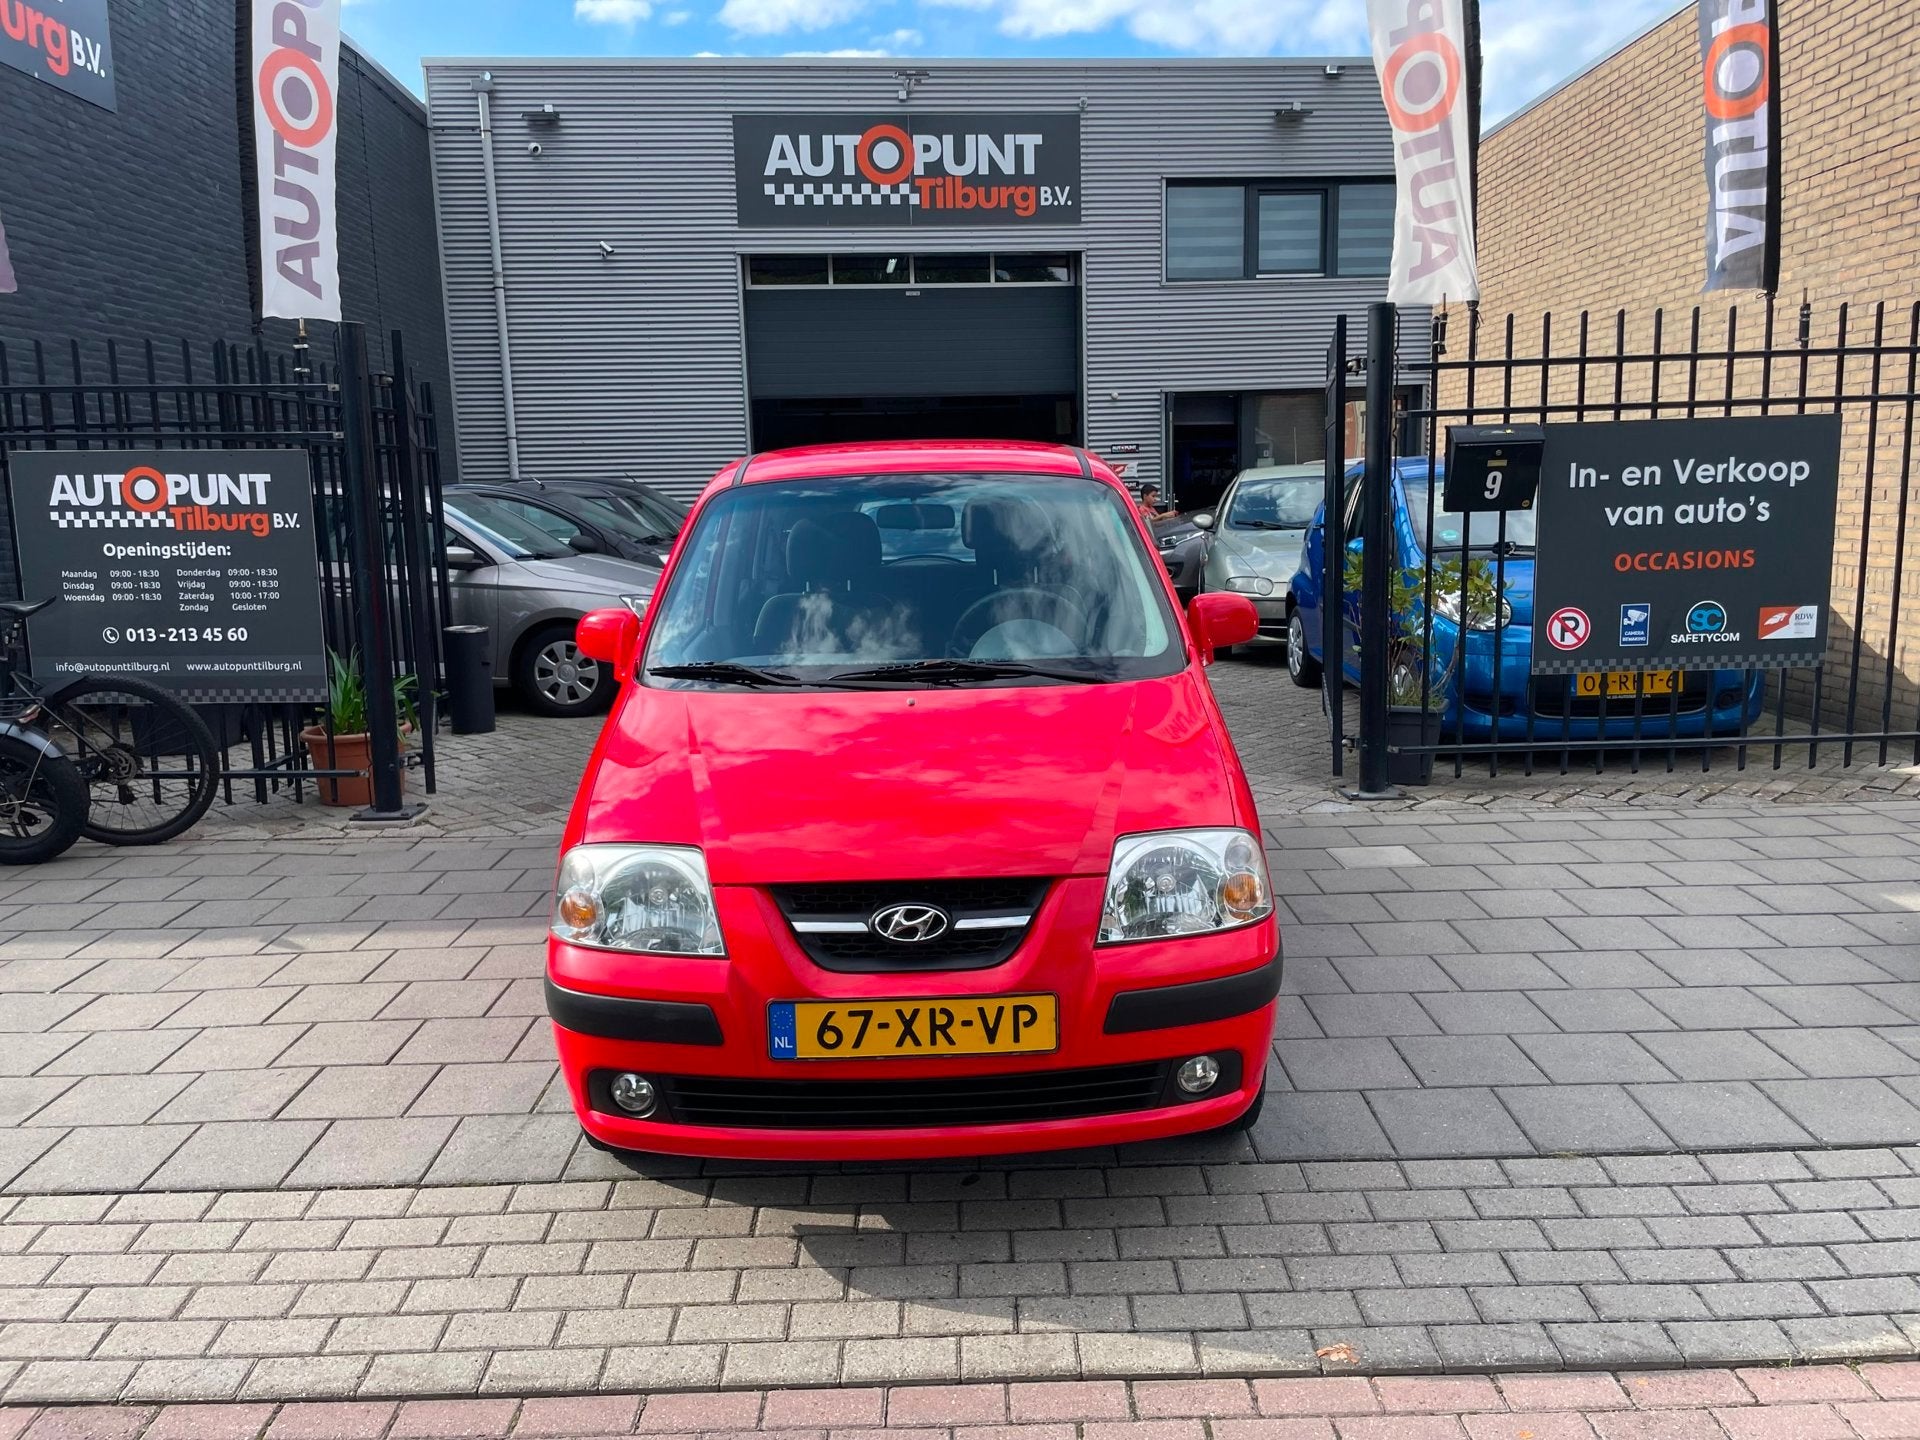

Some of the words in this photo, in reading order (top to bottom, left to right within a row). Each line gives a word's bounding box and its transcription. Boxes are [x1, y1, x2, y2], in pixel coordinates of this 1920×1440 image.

[70, 29, 106, 78] B.V.
[763, 124, 1043, 186] AUTOPUNT
[914, 176, 1037, 217] Tilburg
[1040, 185, 1073, 207] B.V.
[1569, 462, 1610, 489] In-
[1621, 464, 1662, 487] en
[1672, 456, 1810, 488] Verkoop
[49, 466, 271, 513] AUTOPUNT
[1483, 470, 1503, 500] 9
[1604, 504, 1664, 527] van
[1674, 495, 1771, 525] auto's
[170, 506, 270, 537] Tilburg
[273, 512, 300, 530] B.V.
[103, 542, 232, 559] Openingstijden:
[1614, 549, 1756, 573] OCCASIONS
[61, 569, 98, 579] Maandag
[109, 570, 132, 578] 09:00
[138, 569, 160, 578] 18:30
[176, 568, 221, 578] Donderdag
[227, 568, 250, 576] 09:00
[256, 568, 278, 576] 18:30
[62, 582, 95, 591] Dinsdag
[110, 581, 133, 589] 09:00
[140, 581, 161, 589] 18:30
[177, 580, 206, 590] Vrijdag
[228, 580, 251, 588] 09:00
[257, 580, 279, 588] 18:30
[64, 593, 105, 603] Woensdag
[112, 593, 134, 601] 09:00
[140, 593, 162, 601] 18:30
[178, 592, 215, 602] Zaterdag
[230, 592, 252, 600] 10:00
[258, 592, 280, 600] 17:00
[179, 603, 209, 613] Zondag
[231, 603, 267, 611] Gesloten
[1794, 612, 1815, 621] RDW
[202, 627, 223, 642] 45
[227, 626, 248, 642] 60
[1670, 632, 1740, 643] SAFETYCOM
[55, 662, 171, 673] info@autopunttilburg.nl
[186, 661, 303, 673] www.autopunttilburg.nl
[774, 1037, 793, 1049] NL
[816, 1004, 1038, 1050] 67-XR-VP
